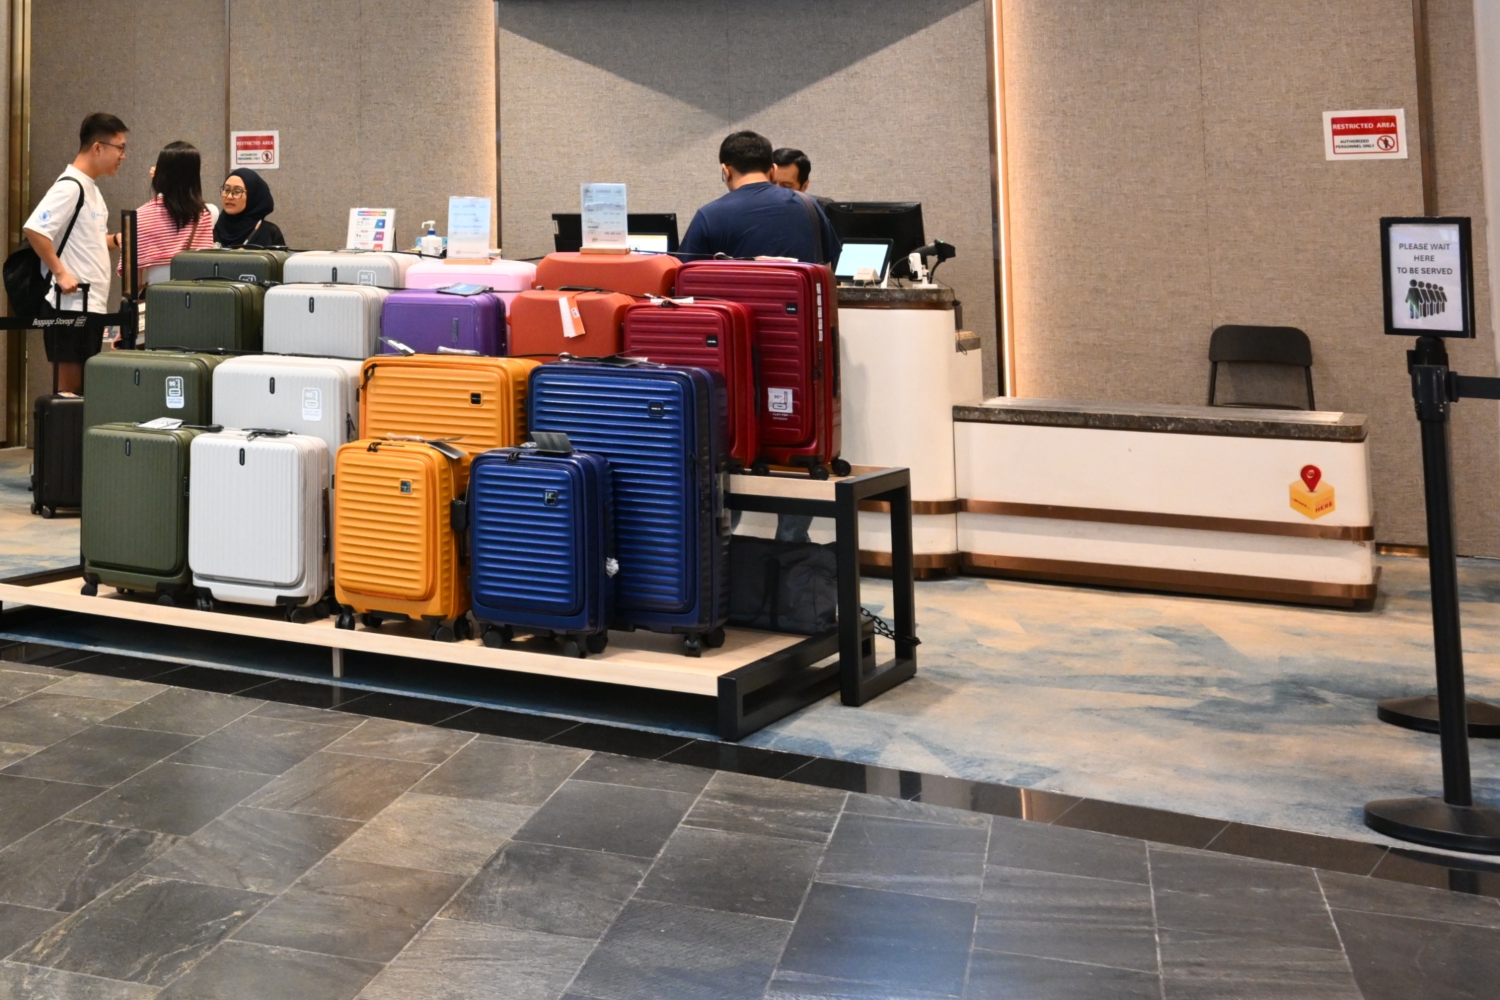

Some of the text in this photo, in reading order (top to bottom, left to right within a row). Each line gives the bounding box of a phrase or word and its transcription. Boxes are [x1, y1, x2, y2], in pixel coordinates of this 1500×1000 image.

[1332, 122, 1374, 130] RESTRICTED
[1398, 242, 1428, 251] PLEASE
[1413, 254, 1435, 262] HERE
[1420, 267, 1453, 275] SERVED
[32, 317, 75, 327] Baggage Storage
[1315, 501, 1333, 513] HERE
